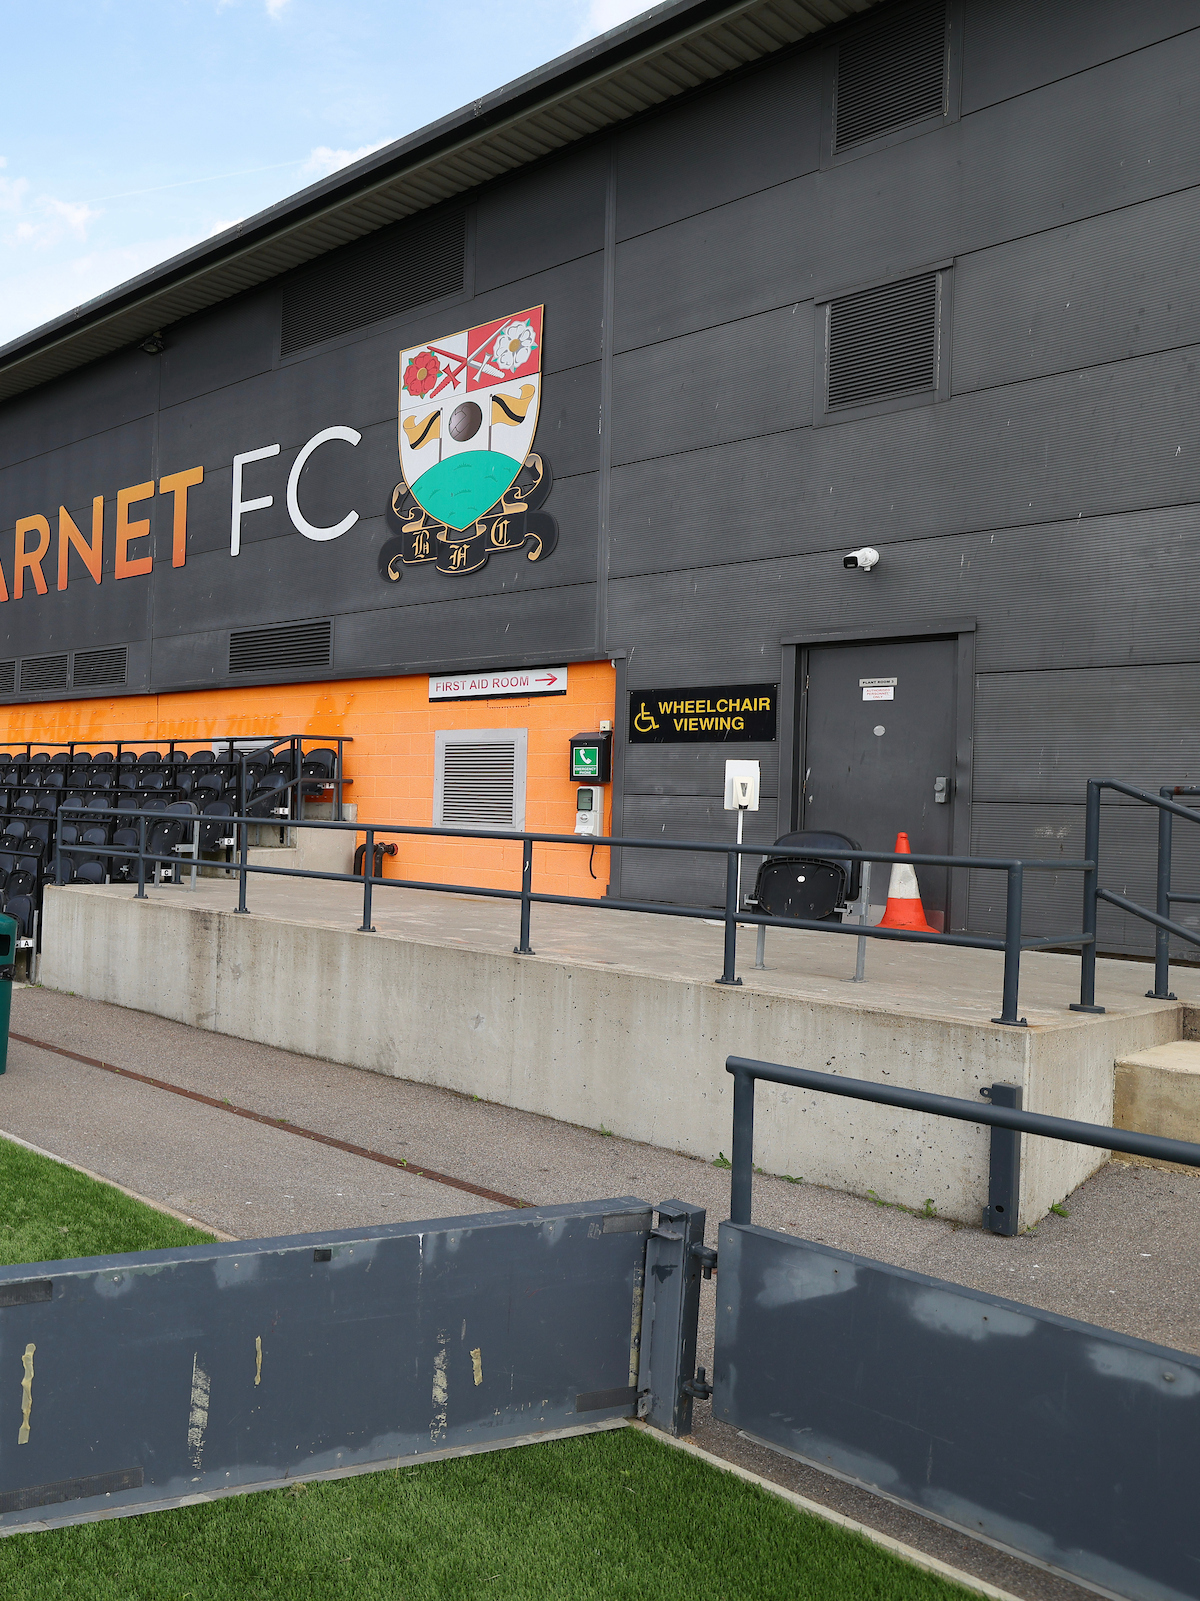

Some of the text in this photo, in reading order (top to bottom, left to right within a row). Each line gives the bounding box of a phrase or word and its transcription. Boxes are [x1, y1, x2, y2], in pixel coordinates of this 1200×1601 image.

[230, 425, 362, 556] FC
[435, 676, 529, 692] FIRST AID ROOM
[658, 697, 771, 714] WHEELCHAIR
[673, 716, 745, 731] VIEWING
